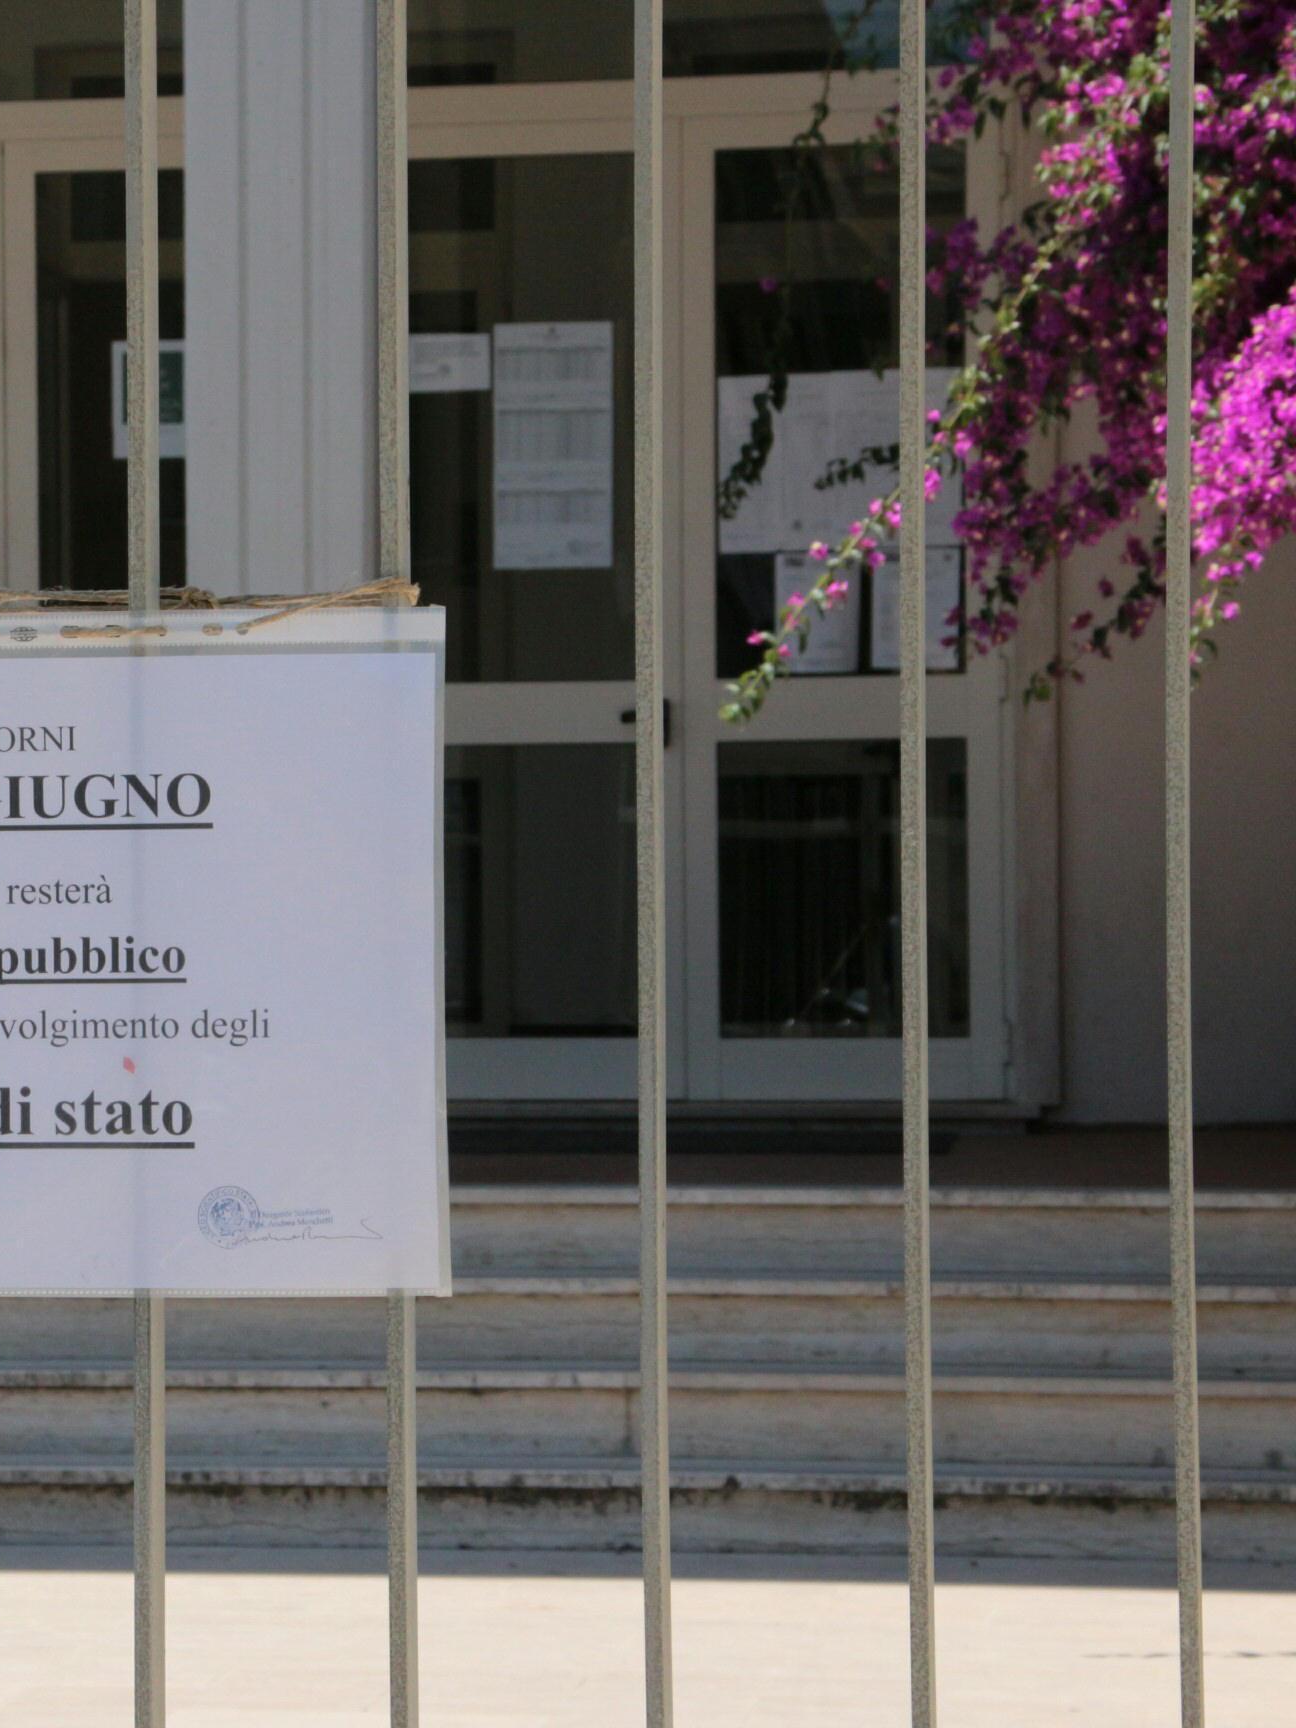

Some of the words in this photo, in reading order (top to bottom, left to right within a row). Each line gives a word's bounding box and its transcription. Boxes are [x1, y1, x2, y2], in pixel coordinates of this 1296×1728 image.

[6, 874, 113, 905] resterà
[191, 1008, 269, 1046] degli
[54, 1089, 193, 1136] stato
